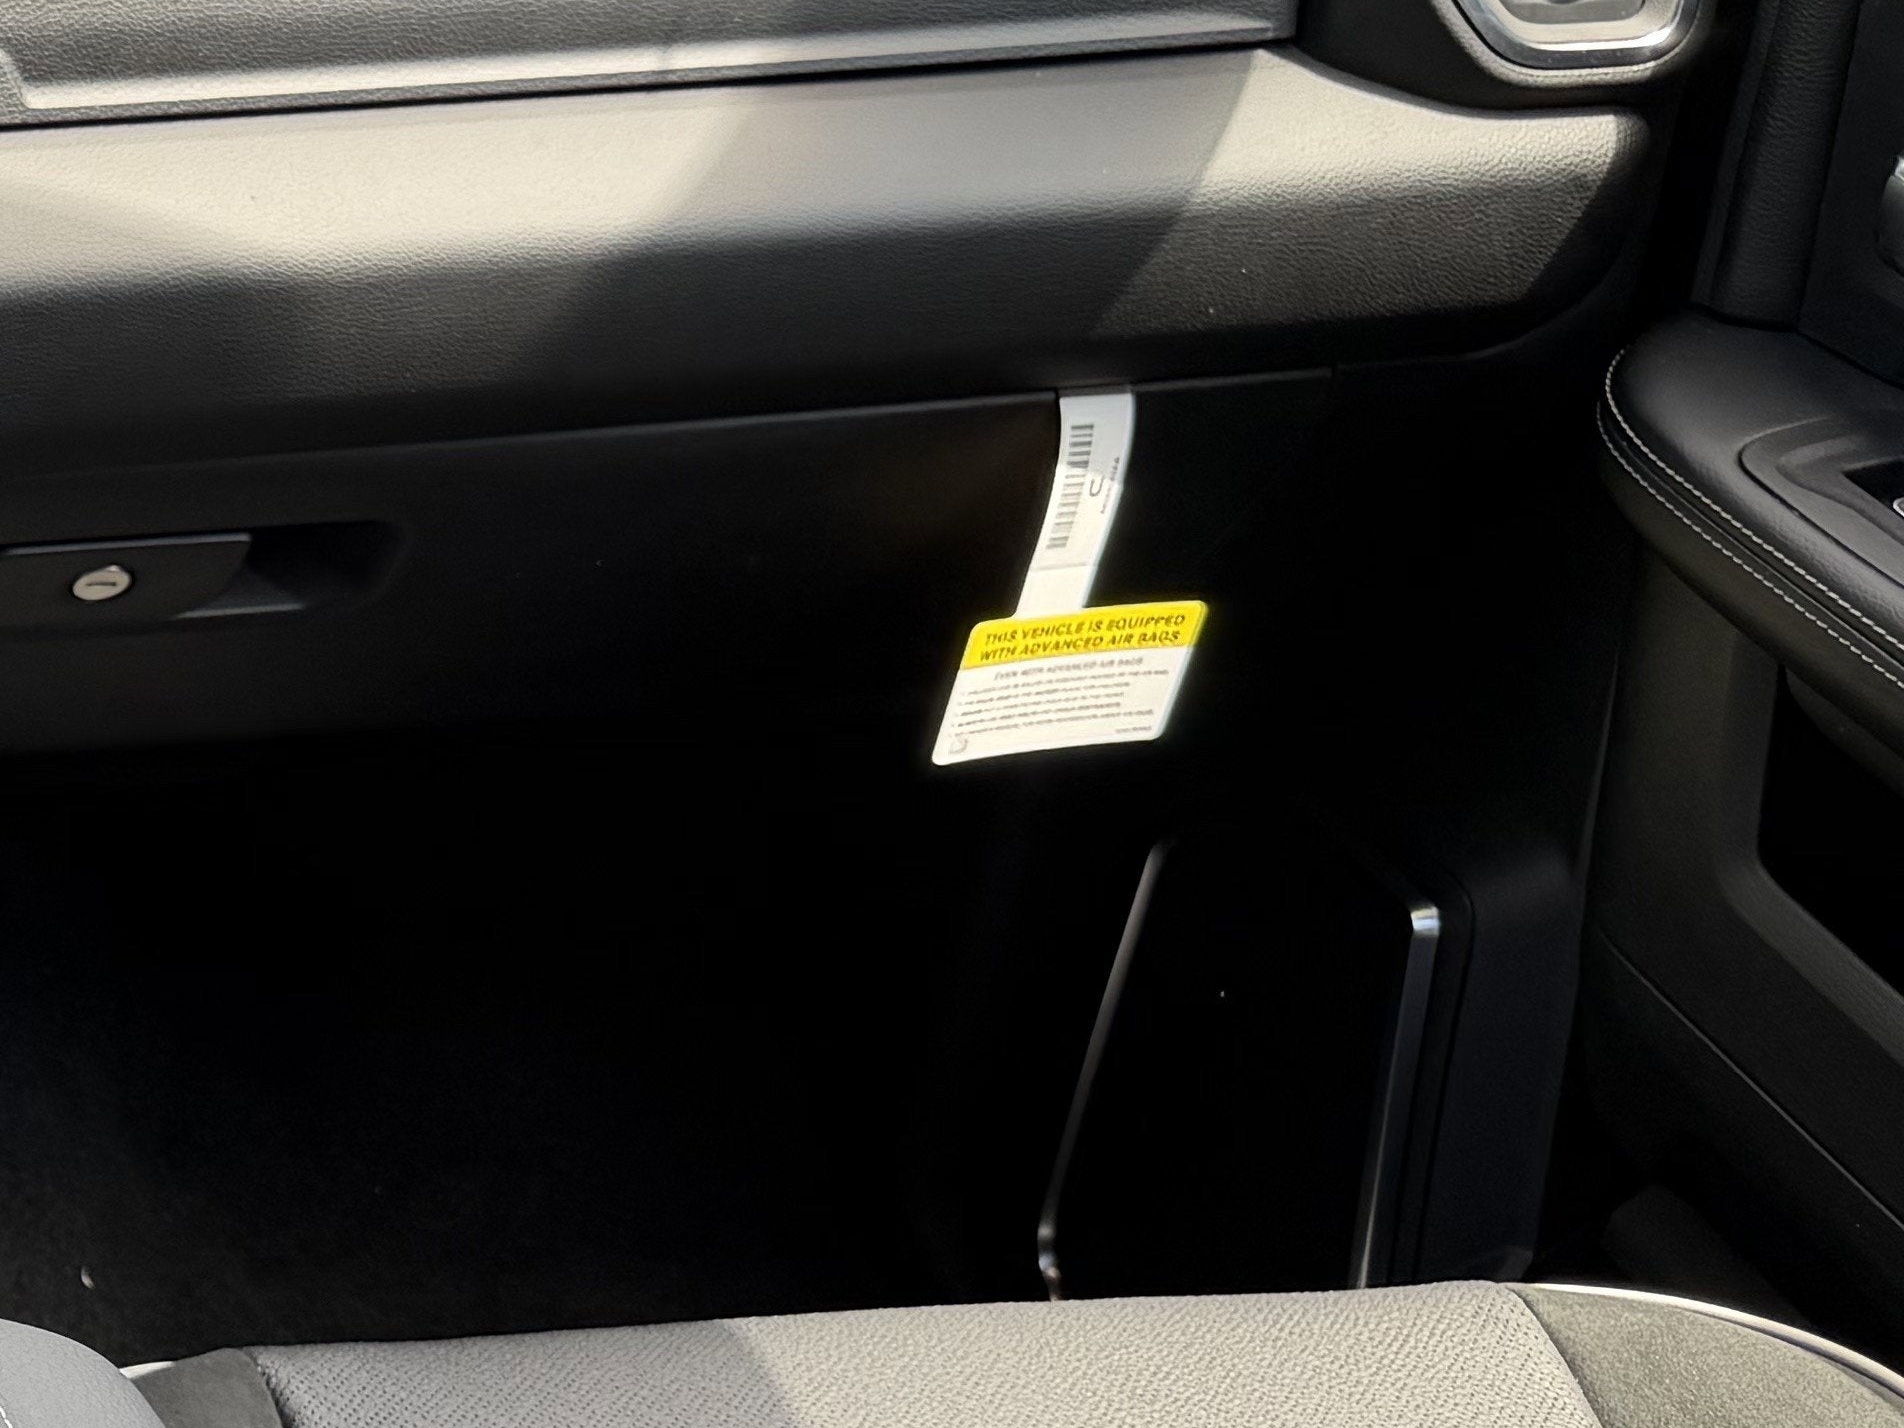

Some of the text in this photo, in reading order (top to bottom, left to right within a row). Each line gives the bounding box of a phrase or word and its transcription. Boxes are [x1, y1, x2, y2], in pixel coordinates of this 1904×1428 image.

[979, 629, 1182, 662] WITH ADVANCED AIR BAGS
[985, 613, 1186, 646] THIS VEHICLE IS EQUIPPED
